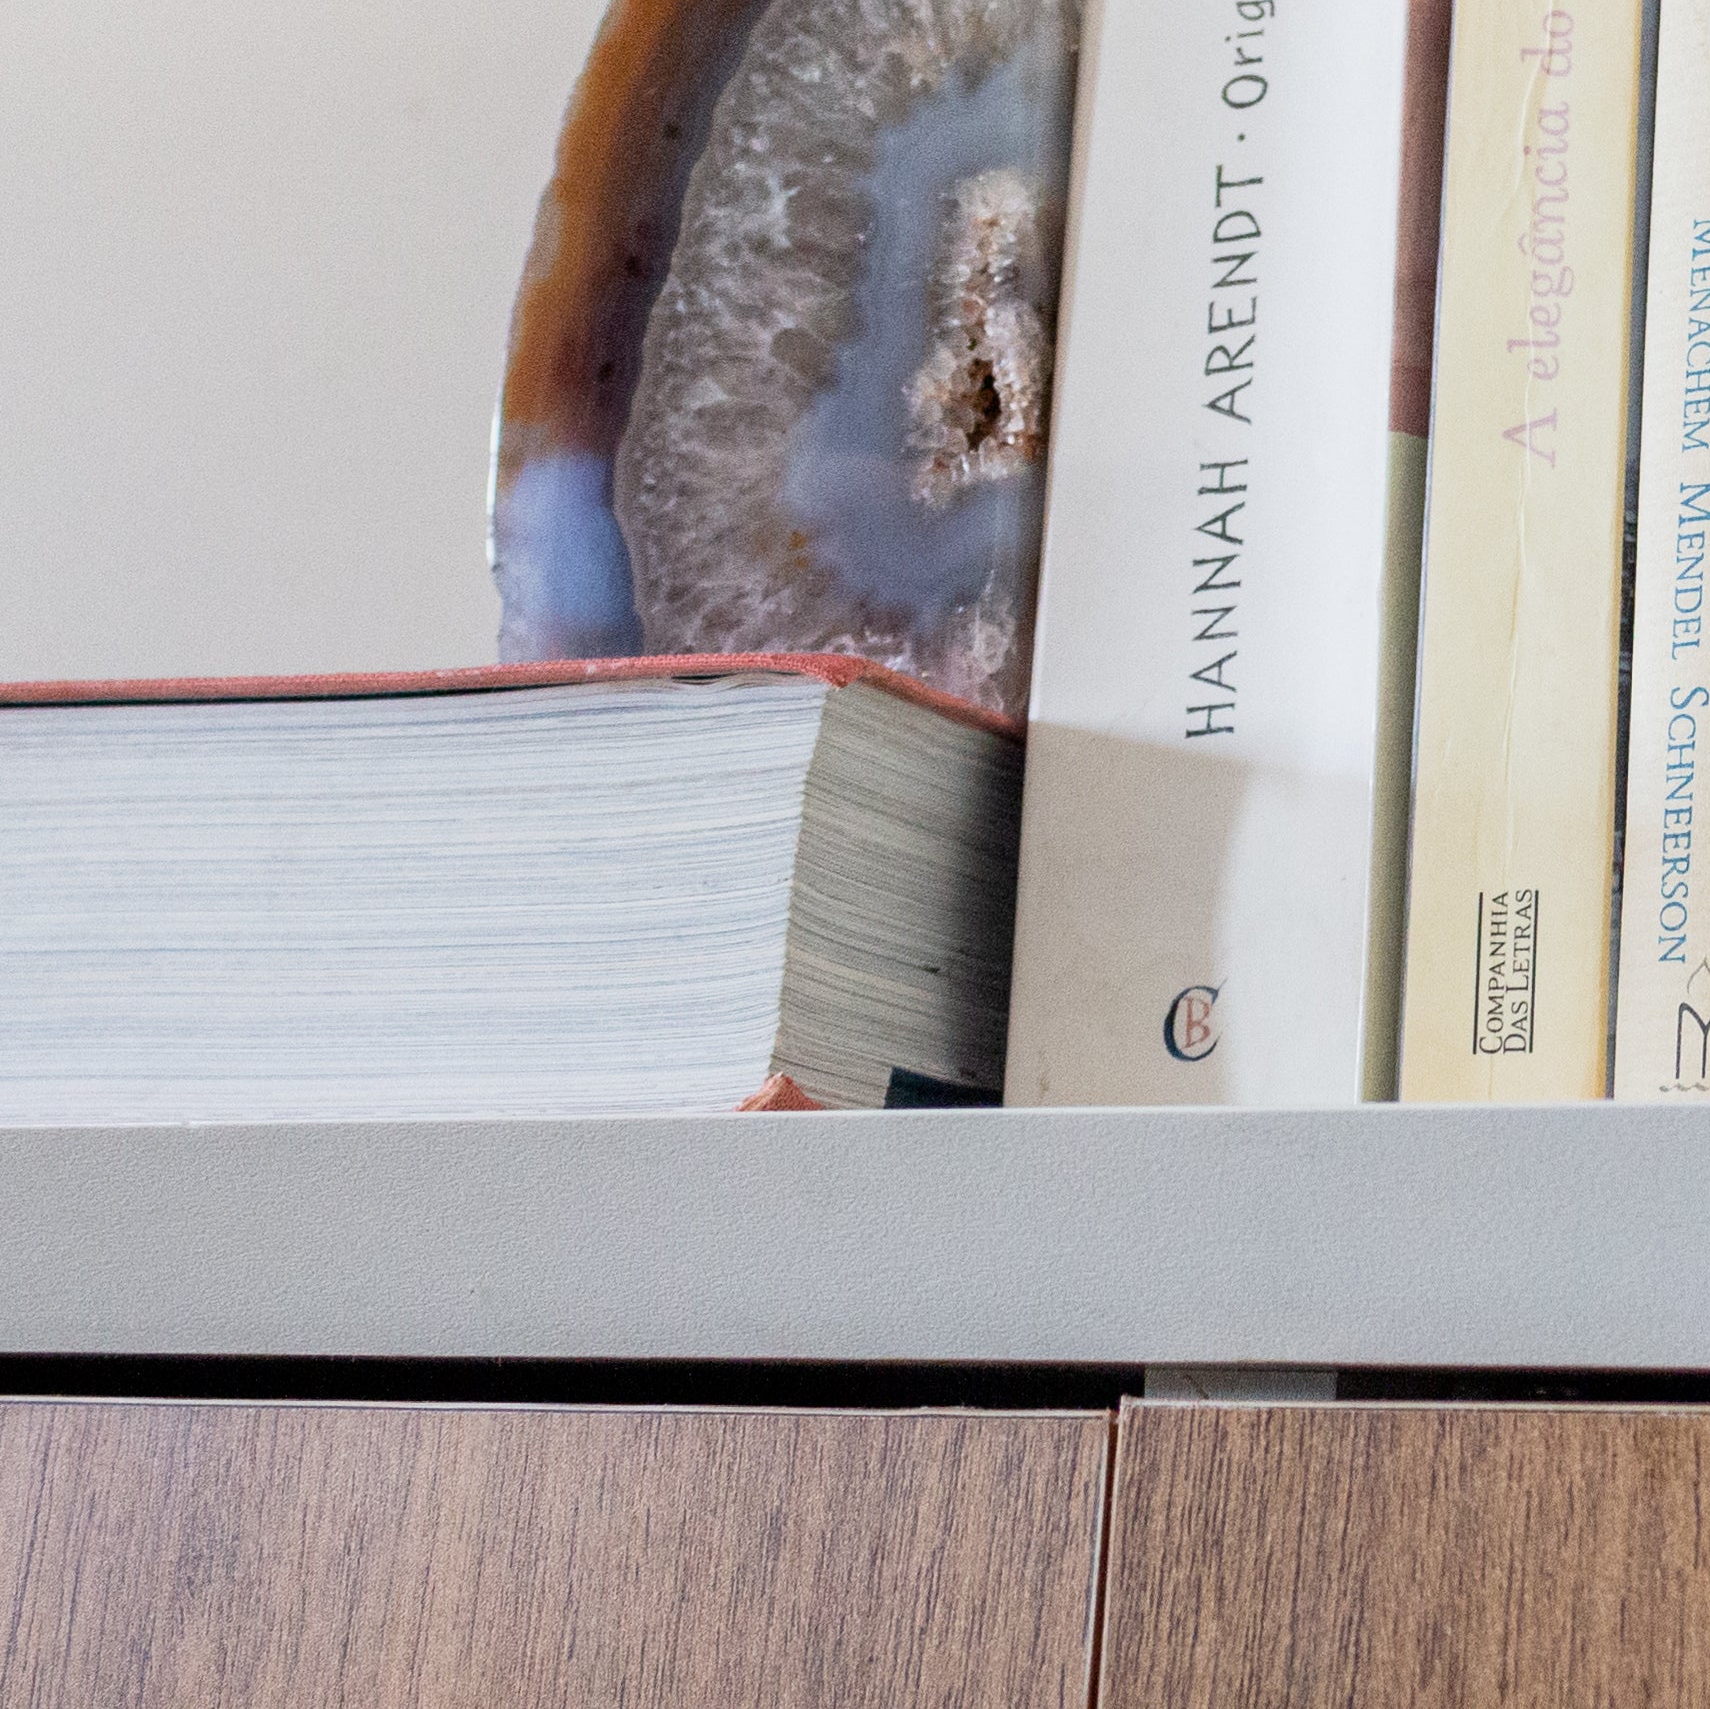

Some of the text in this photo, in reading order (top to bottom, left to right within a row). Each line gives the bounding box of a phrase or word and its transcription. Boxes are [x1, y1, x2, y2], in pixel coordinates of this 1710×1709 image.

[1520, 9, 1574, 77] do
[1204, 164, 1264, 424] ARENDT
[1506, 101, 1575, 382] elegância
[1502, 407, 1558, 470] A
[1185, 458, 1249, 739] HANNAH
[1658, 686, 1710, 964] SCHNEERSON
[1479, 891, 1509, 1054] COMPANHIA
[1503, 889, 1533, 1054] DAS LETRAS
